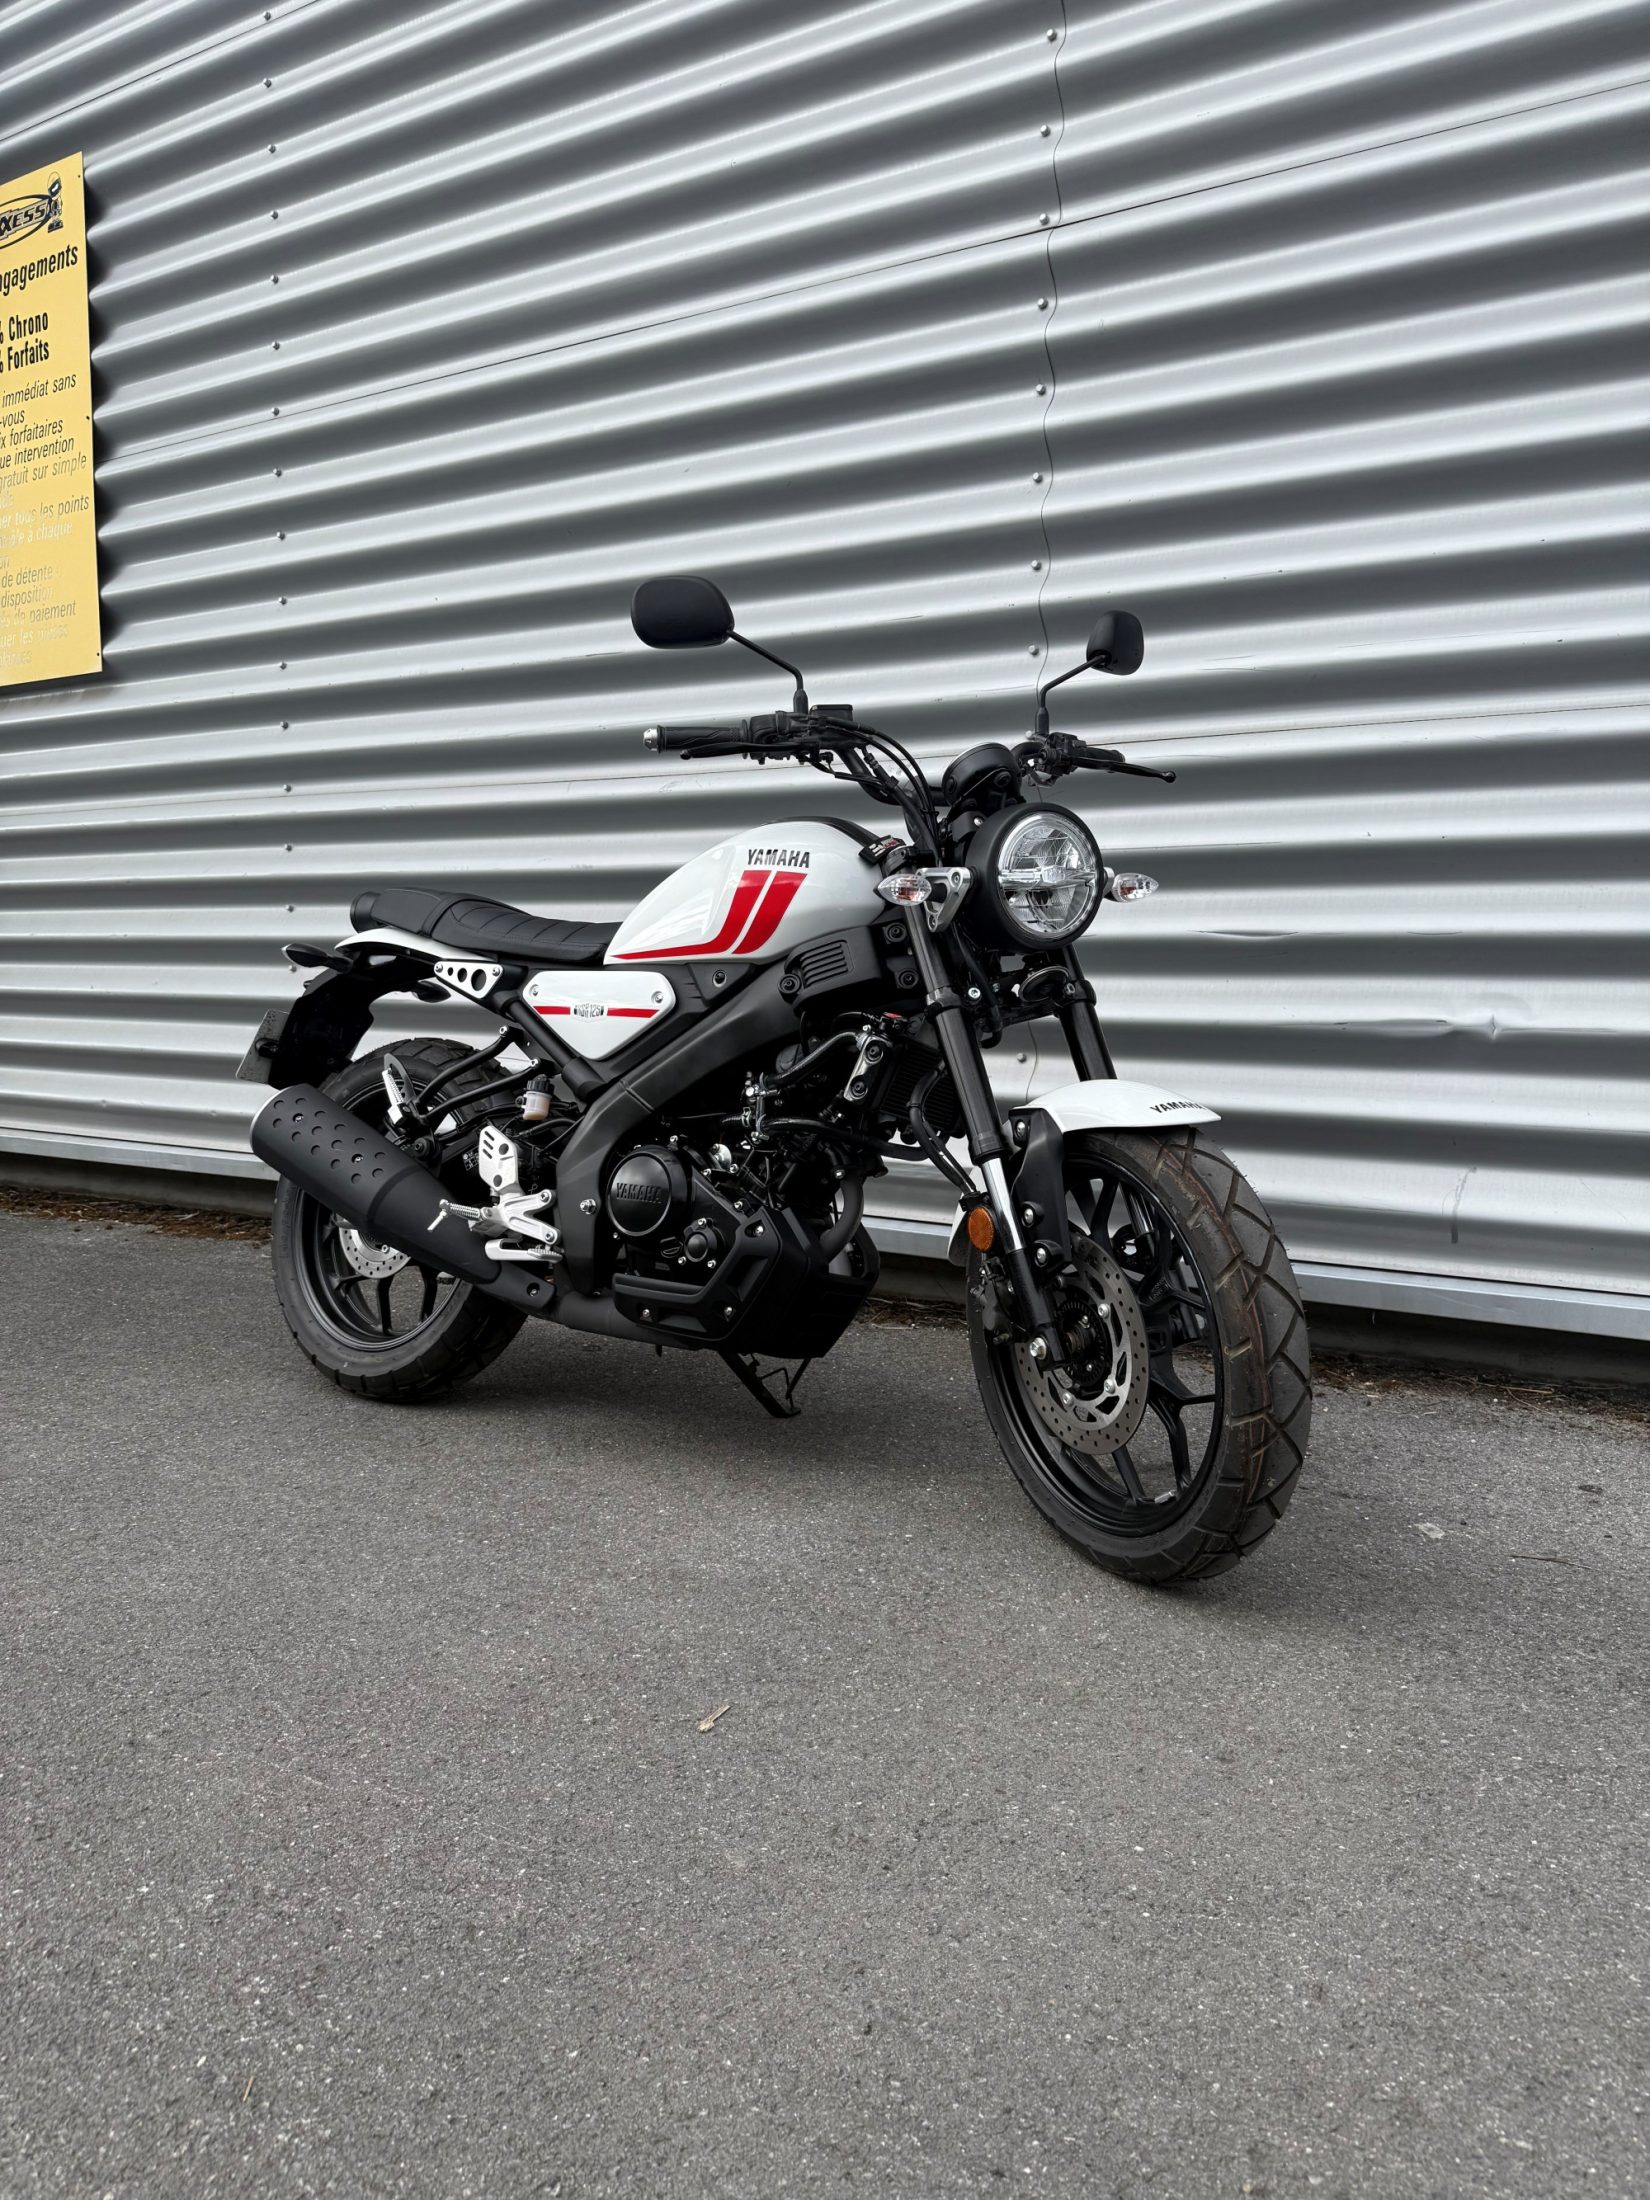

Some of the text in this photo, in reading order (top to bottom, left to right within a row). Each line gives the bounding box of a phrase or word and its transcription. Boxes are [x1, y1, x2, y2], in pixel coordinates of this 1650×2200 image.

[0, 245, 78, 297] gagements
[9, 312, 48, 341] Chrono
[7, 338, 49, 371] Forfaits
[2, 374, 77, 408] immédiat sans
[10, 419, 63, 447] forfaitaires
[15, 436, 74, 465] intervention
[32, 465, 48, 481] sur
[52, 451, 87, 476] simple
[40, 502, 54, 518] les
[57, 495, 90, 518] points
[1, 571, 14, 588] de
[16, 565, 53, 586] détente
[1, 583, 53, 610] disposition
[30, 600, 76, 624] paiement
[747, 848, 810, 869] YAMAHA
[616, 1182, 663, 1203] YAMAHA
